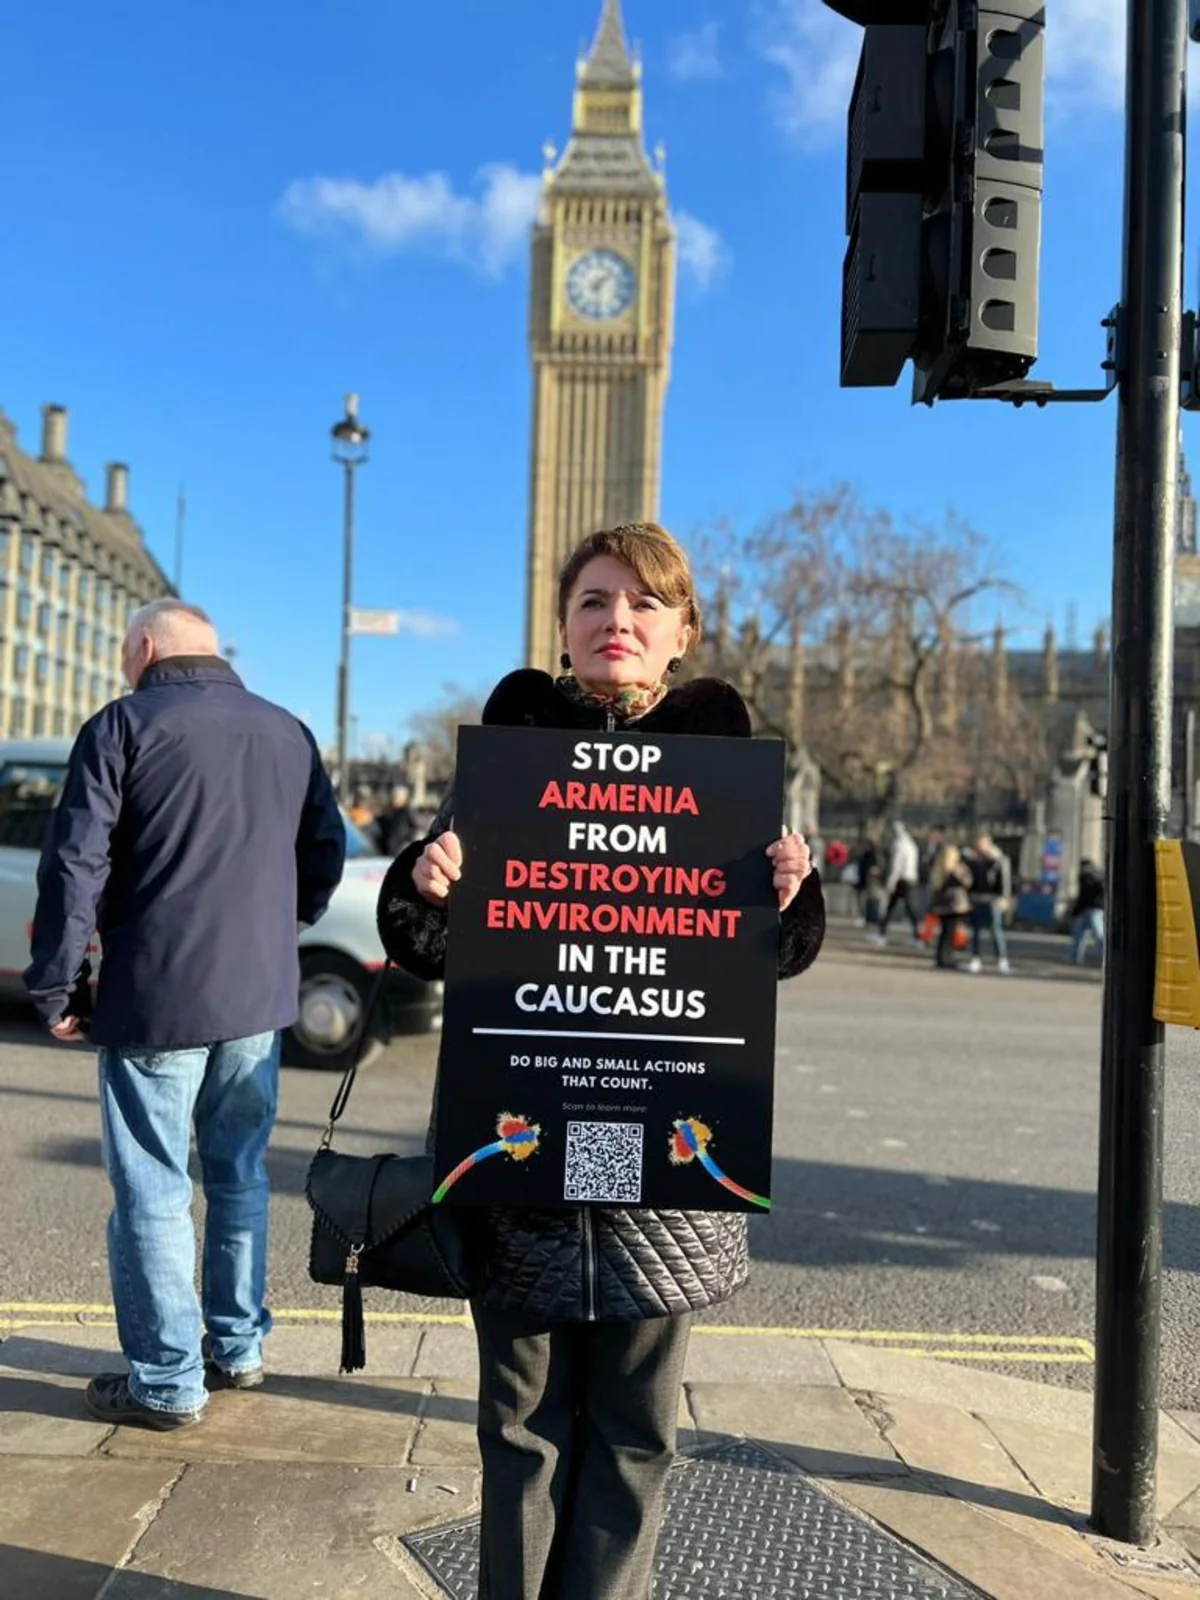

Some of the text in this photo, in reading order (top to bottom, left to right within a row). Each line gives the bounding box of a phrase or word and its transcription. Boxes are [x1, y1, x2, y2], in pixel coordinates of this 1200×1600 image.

[571, 741, 662, 773] STOP
[538, 781, 699, 816] ARMENIA
[568, 821, 667, 854] FROM
[505, 859, 726, 897] DESTROYING
[487, 900, 742, 939] ENVIRONMENT
[558, 943, 667, 976] IN THE
[515, 982, 706, 1020] CAUCASUS
[510, 1055, 706, 1074] DO BIG AND SMALL ACTIONS
[561, 1075, 653, 1090] THAT COUNT.
